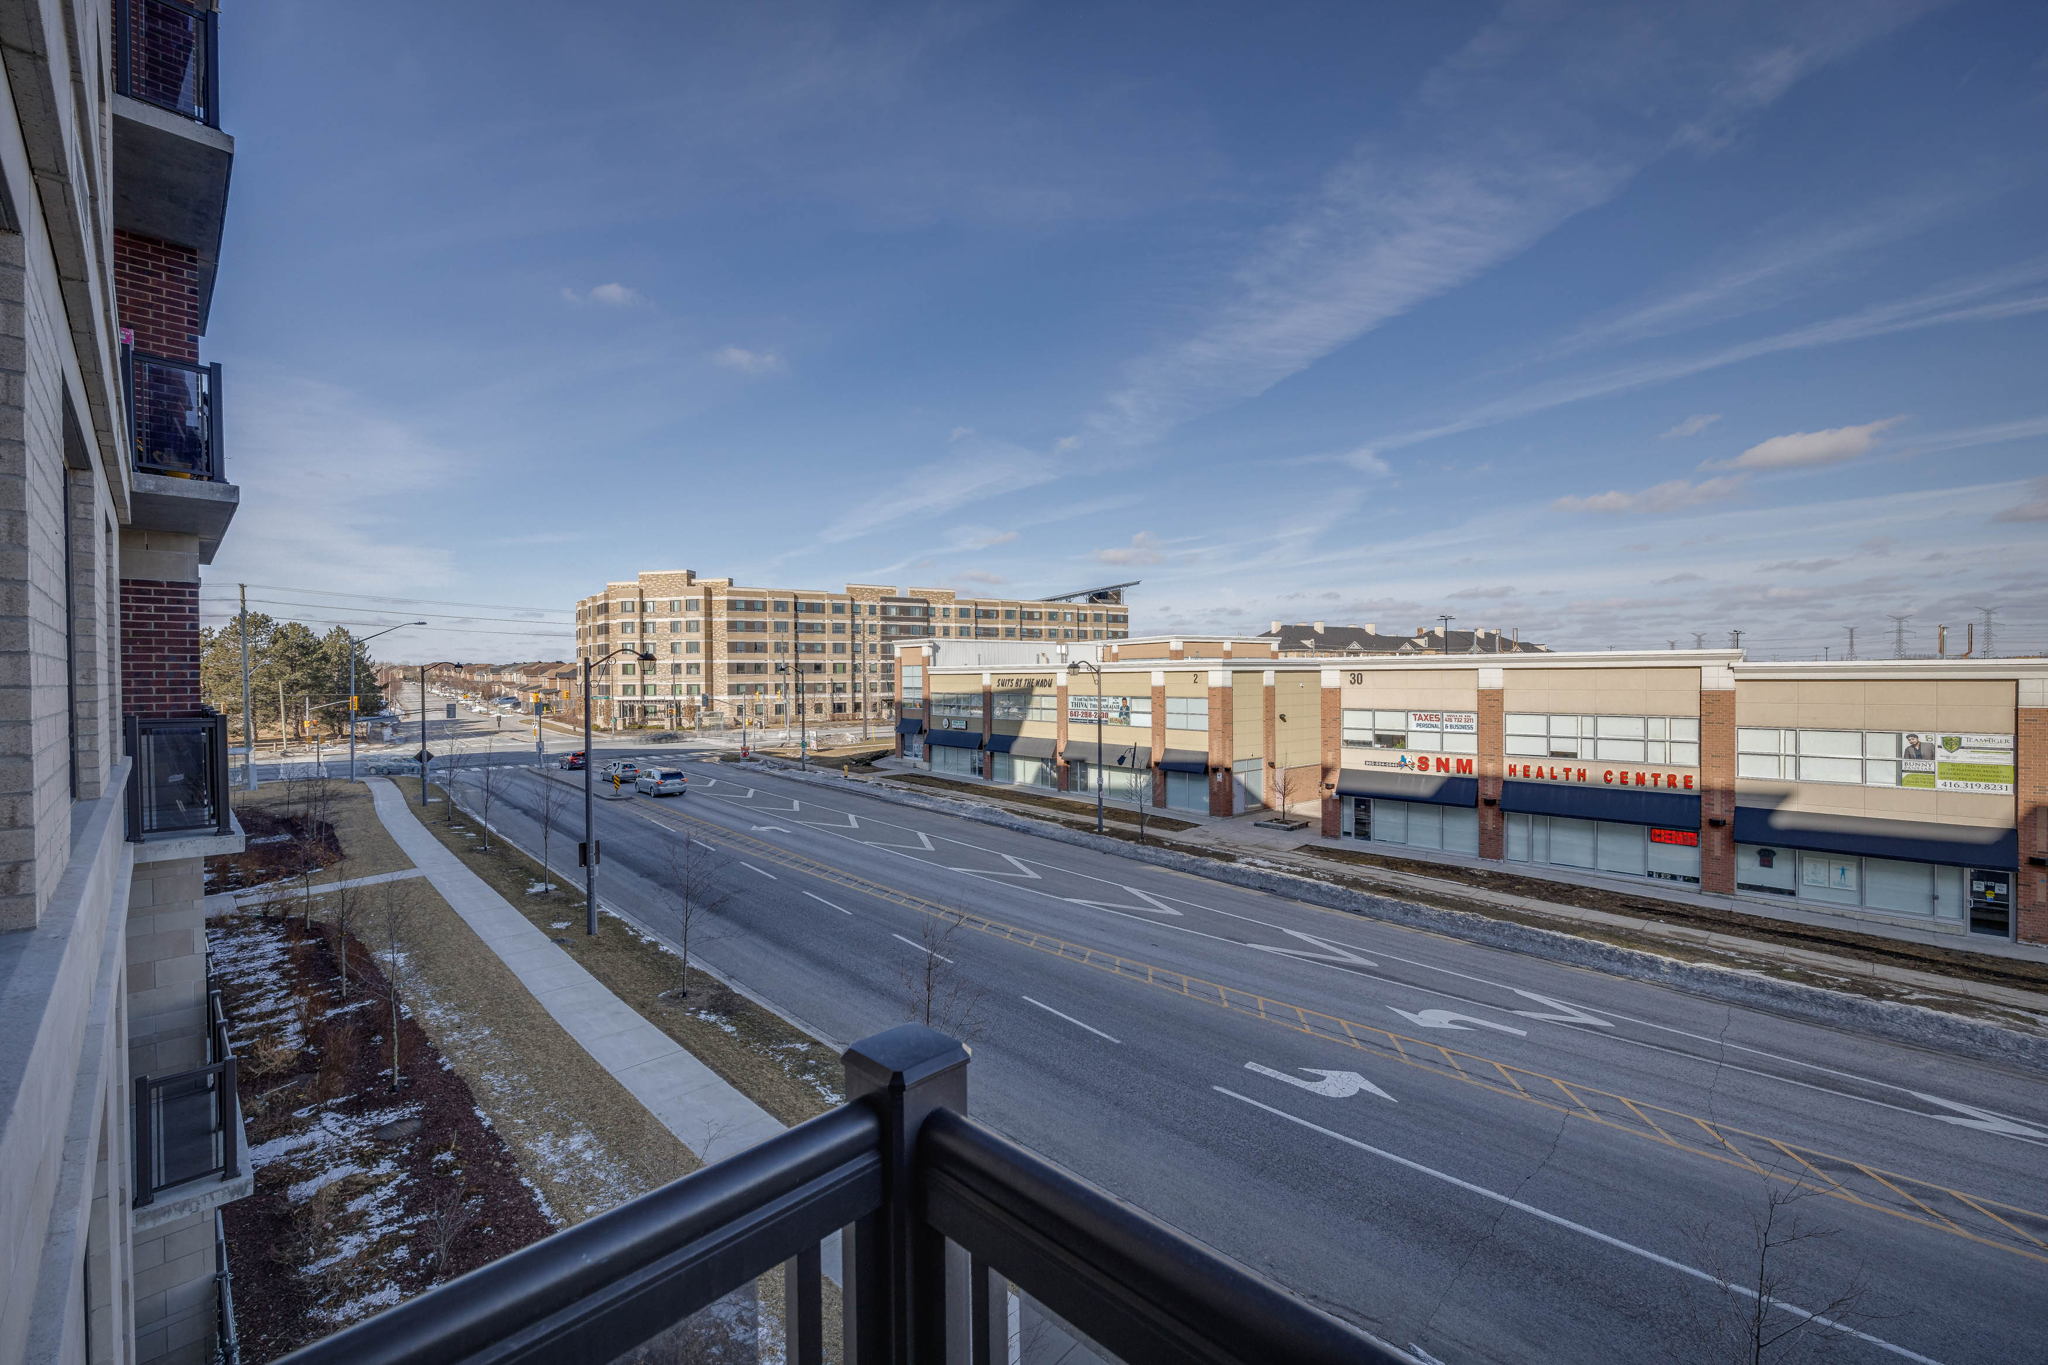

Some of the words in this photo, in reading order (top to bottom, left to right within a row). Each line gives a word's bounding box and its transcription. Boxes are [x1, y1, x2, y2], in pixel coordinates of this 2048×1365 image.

[996, 678, 1014, 687] SUITS
[1024, 678, 1035, 688] THE
[1193, 673, 1198, 683] 2
[1350, 672, 1363, 685] 30
[1412, 713, 1440, 722] TAXES
[1417, 756, 1473, 774] SNM
[1508, 764, 1587, 782] HEALTH
[1603, 770, 1694, 789] CENTRE
